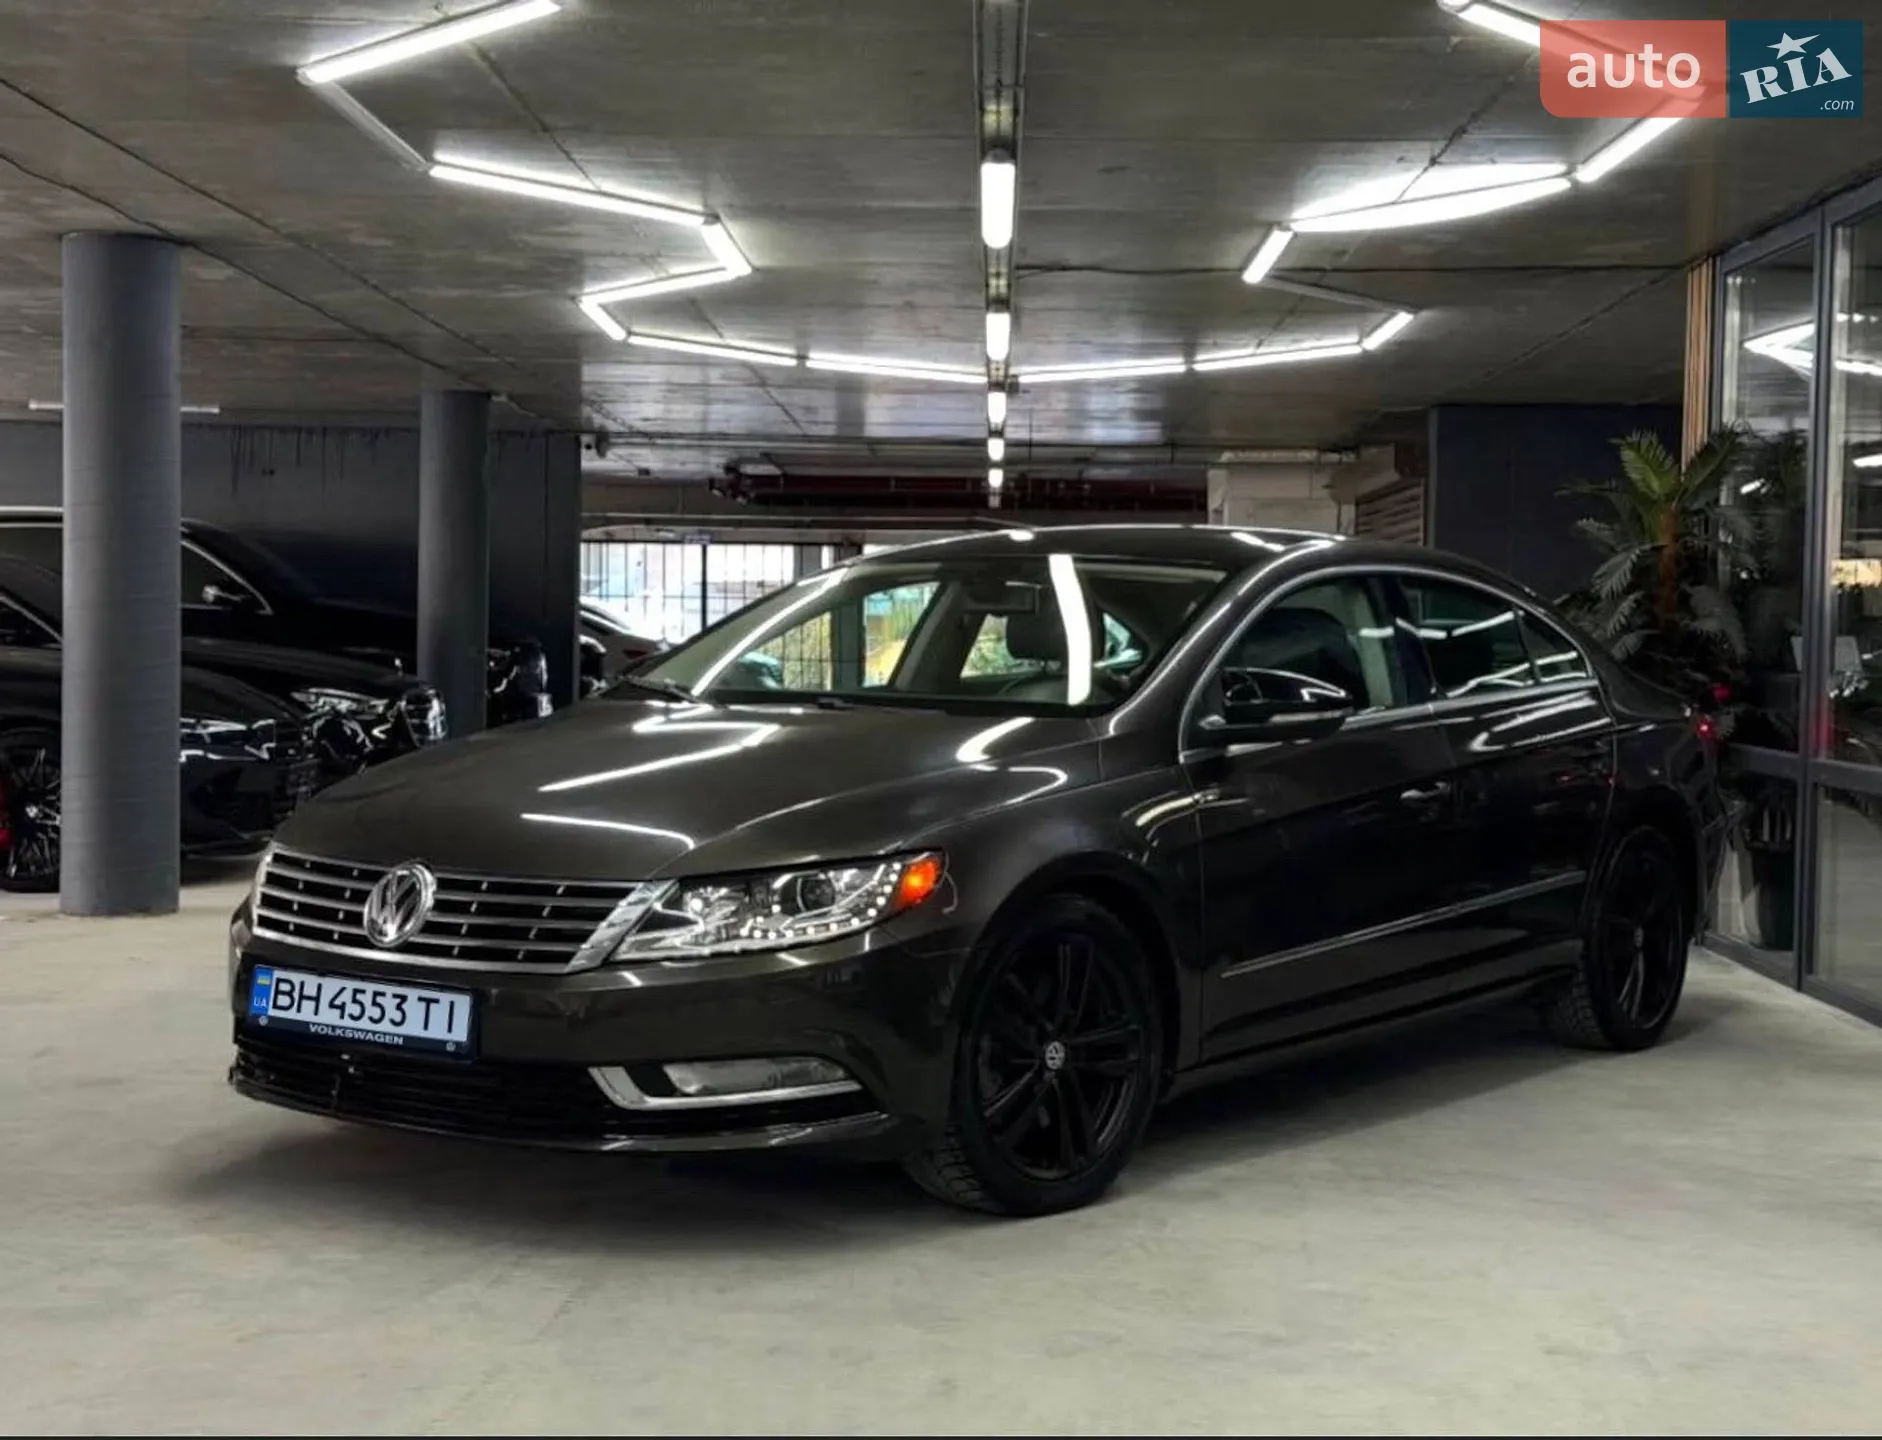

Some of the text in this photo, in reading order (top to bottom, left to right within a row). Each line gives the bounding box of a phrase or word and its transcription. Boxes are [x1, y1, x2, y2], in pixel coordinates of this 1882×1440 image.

[272, 978, 455, 1034] BH 4553 TI
[308, 1023, 404, 1046] VOLKSWAGEN
